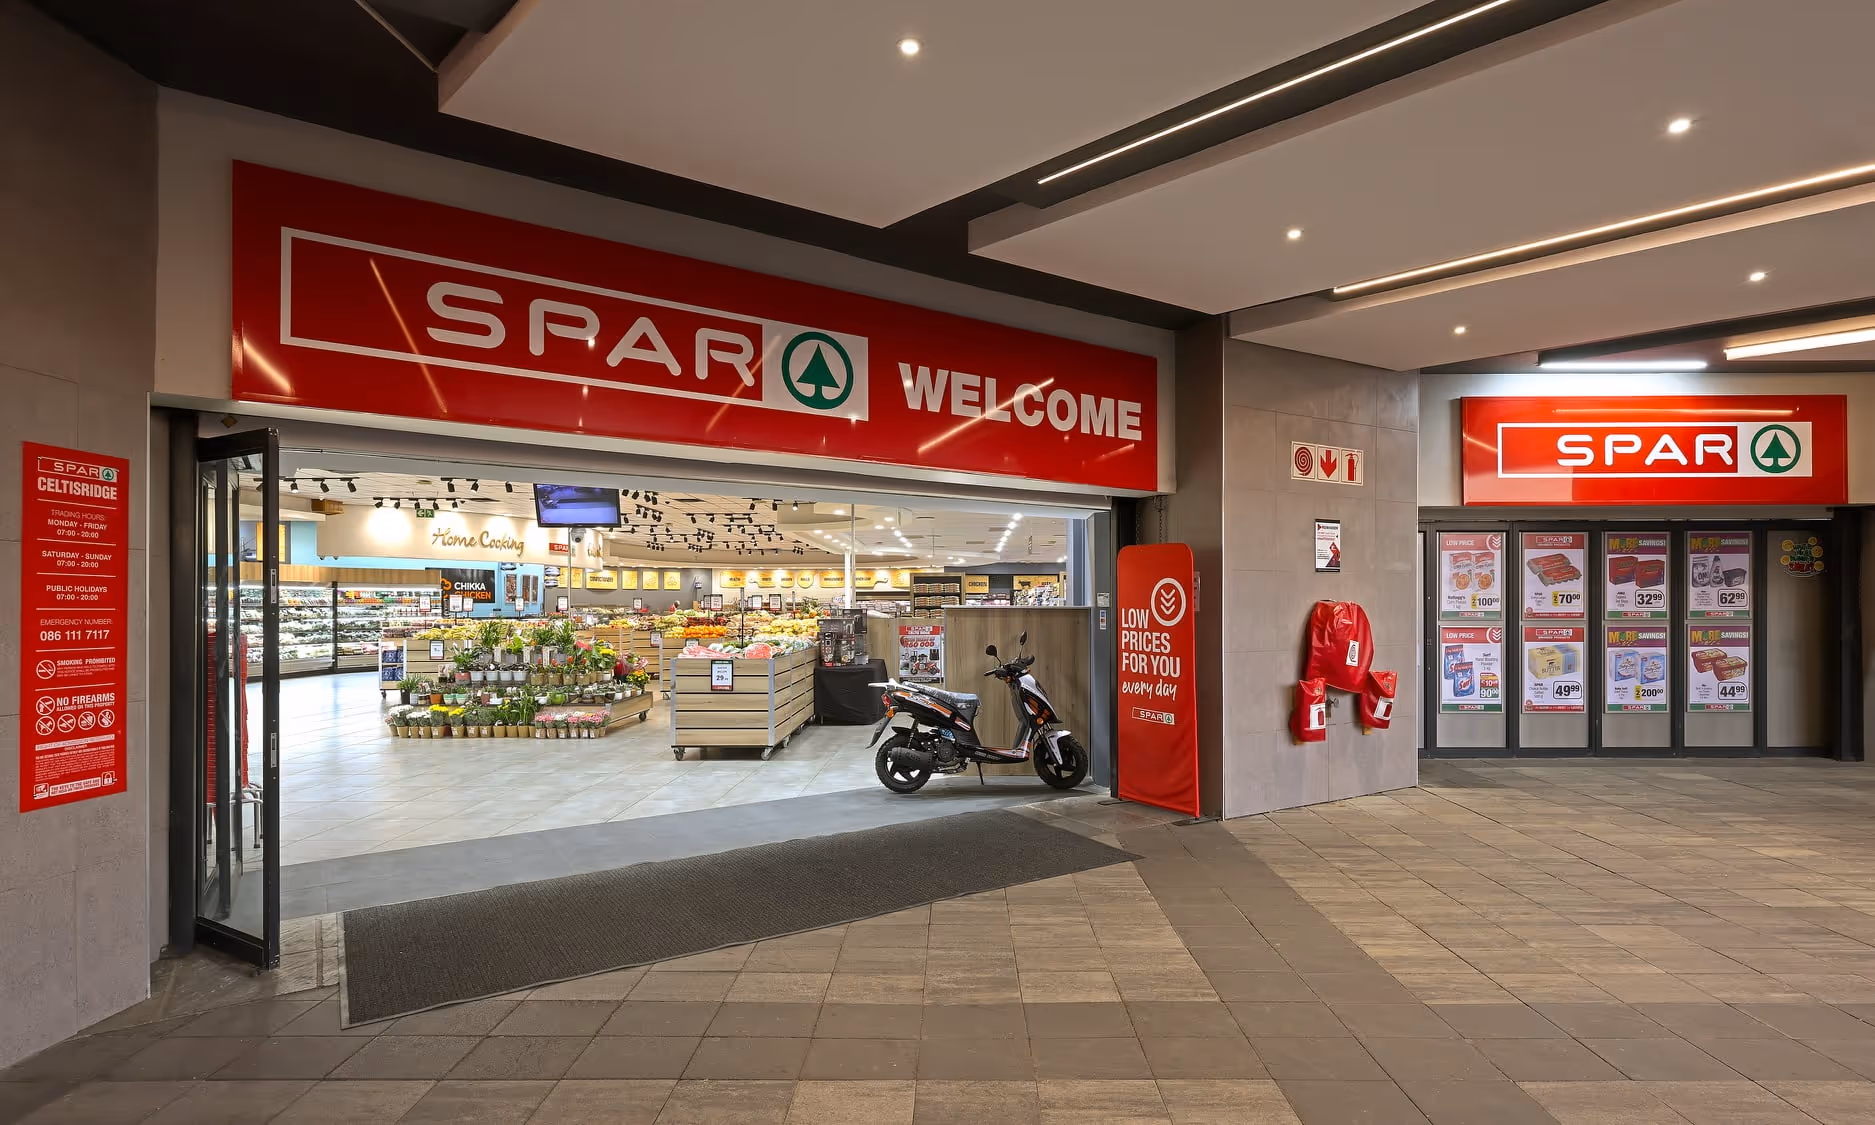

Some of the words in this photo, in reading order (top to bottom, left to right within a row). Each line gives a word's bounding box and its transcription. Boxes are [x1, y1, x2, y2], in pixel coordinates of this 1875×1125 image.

[426, 281, 756, 388] SPAR
[898, 361, 1143, 443] WELCOME
[1556, 433, 1734, 466] SPAR
[53, 462, 99, 477] SPAR
[37, 476, 118, 500] CELTISRIDGE
[51, 509, 80, 519] TRADING
[47, 519, 78, 528] MONDAY
[84, 522, 107, 530] FRIDAY
[432, 528, 477, 547] Home
[479, 530, 524, 557] Cooking
[42, 550, 80, 559] SATURDAY
[454, 582, 486, 590] CHIKKA
[40, 618, 83, 626] EMERGENCY
[1122, 608, 1149, 629] LOW
[40, 630, 62, 642] 086
[65, 630, 81, 640] 111
[86, 630, 110, 640] 7117
[1122, 630, 1170, 654] PRICES
[1122, 652, 1148, 675] FOR
[1150, 654, 1181, 678] YOU
[56, 697, 69, 706] NO
[72, 692, 115, 704] FIREARMS
[1122, 681, 1152, 700] every
[1155, 679, 1178, 701] day
[1140, 710, 1164, 721] SPAR
